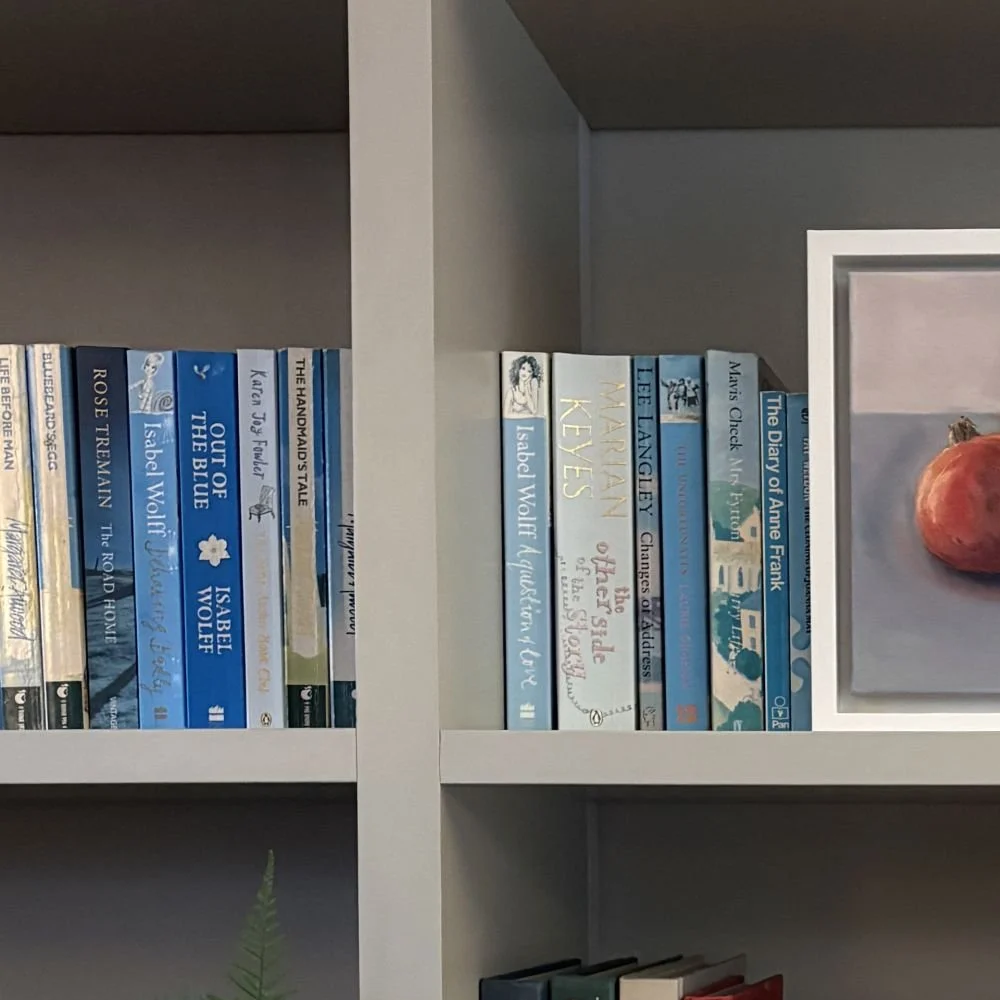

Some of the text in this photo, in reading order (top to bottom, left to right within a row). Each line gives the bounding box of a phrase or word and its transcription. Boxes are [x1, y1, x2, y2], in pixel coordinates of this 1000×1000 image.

[1, 357, 14, 470] LIFE BEFORE MAN
[43, 352, 58, 471] BLUEBEARD'S EGG
[93, 368, 112, 509] ROSE TREMAIN
[191, 411, 209, 509] THE BLUE
[209, 423, 227, 499] OUT OF
[250, 368, 266, 480] Karen Joy Fowler
[296, 358, 308, 507] THE HANDMAID'S TALE
[560, 398, 593, 499] KEYES
[601, 380, 628, 519] MARIAN
[637, 367, 653, 516] LEE LANGLEY
[728, 361, 742, 452] Mavis Cheek
[143, 422, 166, 536] Isabel Wolff
[516, 426, 538, 540] Isabel Wolff
[766, 397, 785, 592] The Diary of Anne Frank
[101, 526, 117, 644] The ROAD HOME
[197, 586, 213, 653] WOLFF
[214, 586, 232, 654] ISABEL
[639, 531, 654, 677] Changes of Address
[772, 720, 789, 728] Pan
